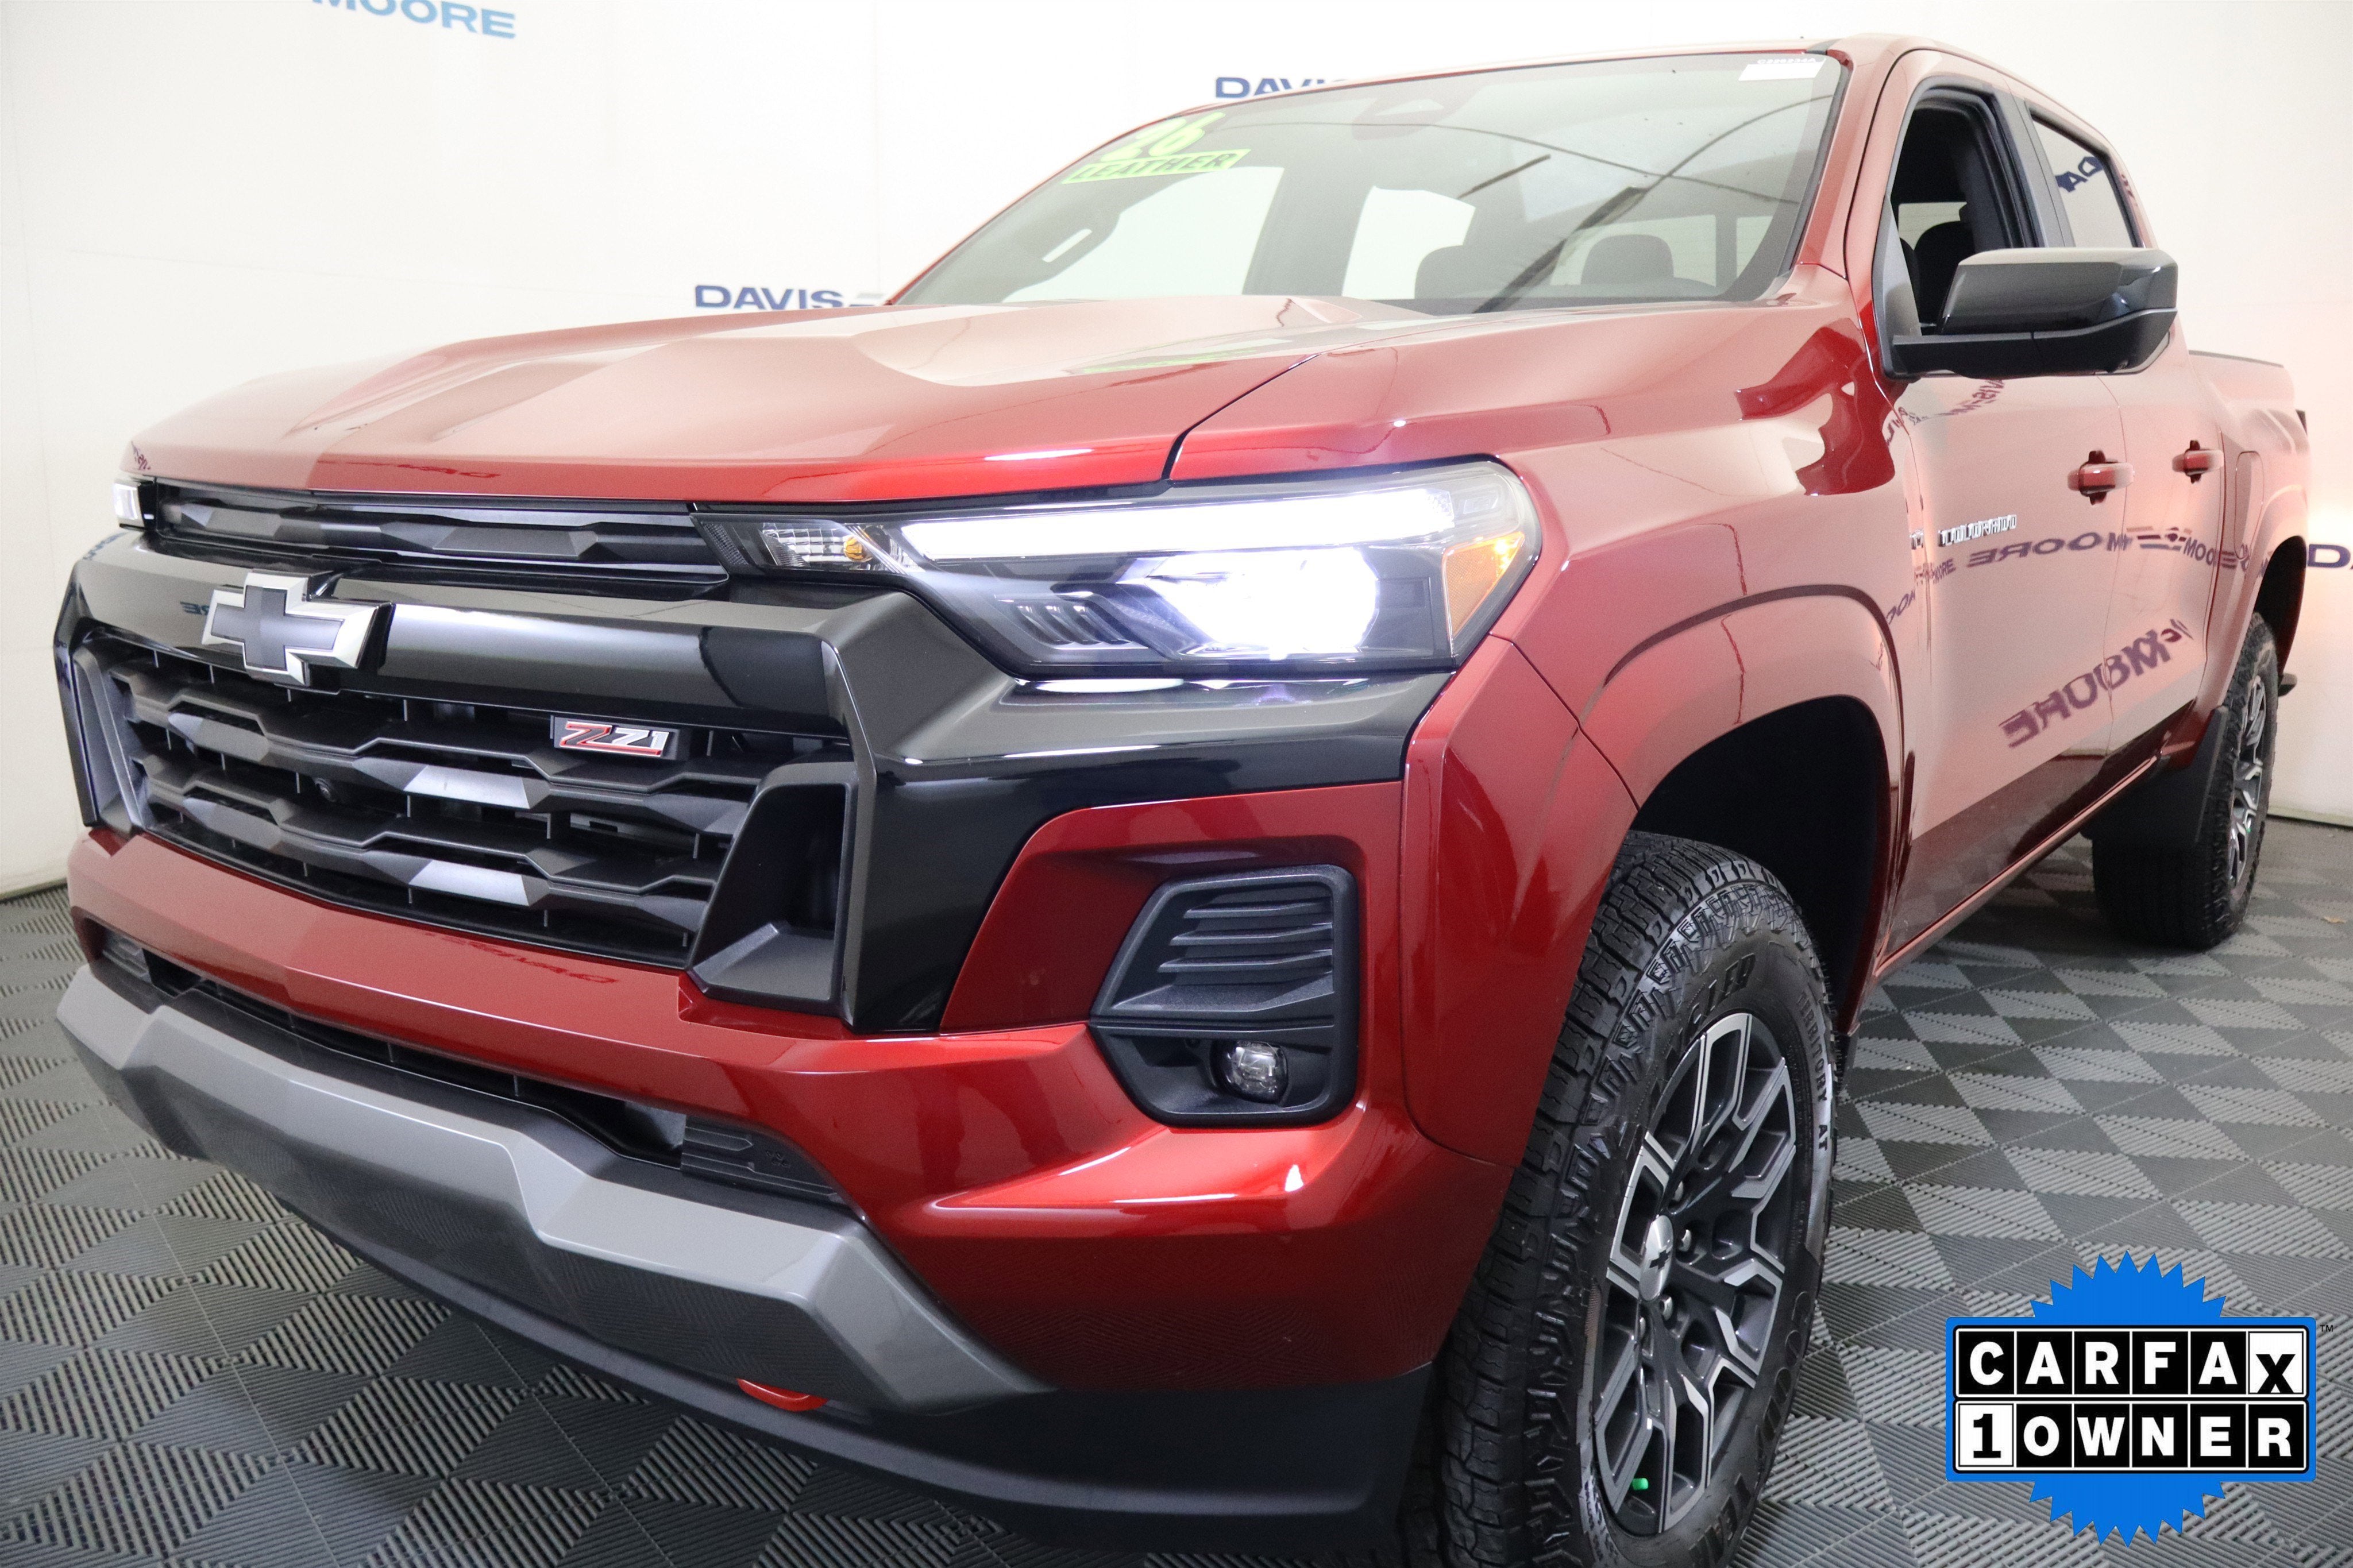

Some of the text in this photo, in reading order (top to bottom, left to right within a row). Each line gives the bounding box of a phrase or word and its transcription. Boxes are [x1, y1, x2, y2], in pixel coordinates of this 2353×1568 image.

[695, 284, 843, 310] DAVIS
[560, 721, 670, 758] Z71
[1818, 1124, 1828, 1151] AT
